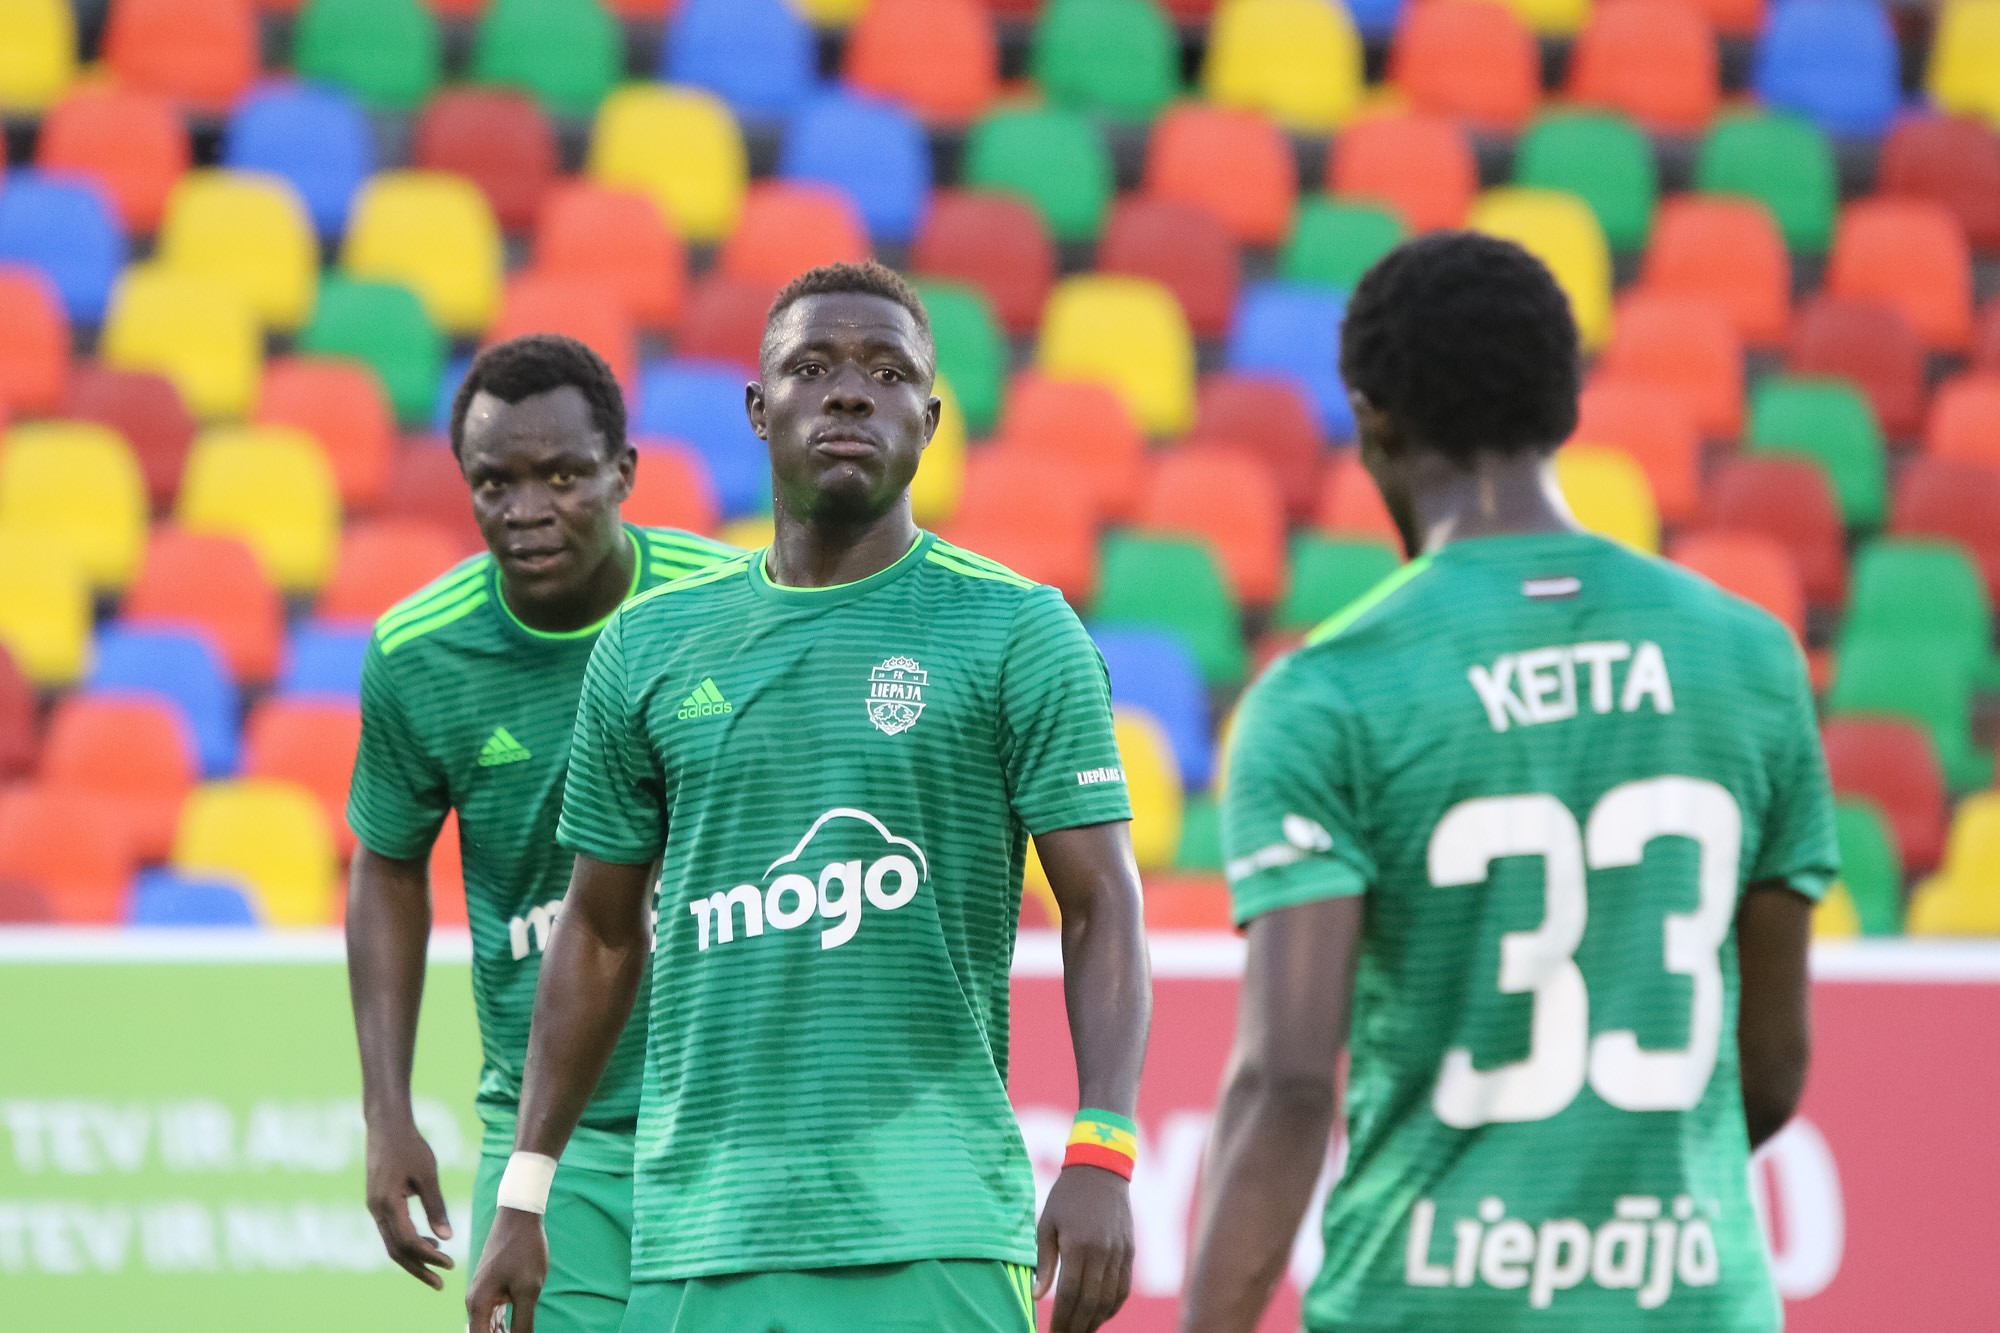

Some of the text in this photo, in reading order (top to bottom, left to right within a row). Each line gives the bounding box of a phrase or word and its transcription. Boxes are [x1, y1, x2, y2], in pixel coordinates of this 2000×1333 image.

[893, 670, 904, 680] FK
[1467, 640, 1675, 733] KEITA
[677, 700, 733, 720] adidas
[1076, 767, 1120, 786] LIEPĀJAS
[689, 854, 919, 952] mogo
[1428, 774, 1743, 1130] 33
